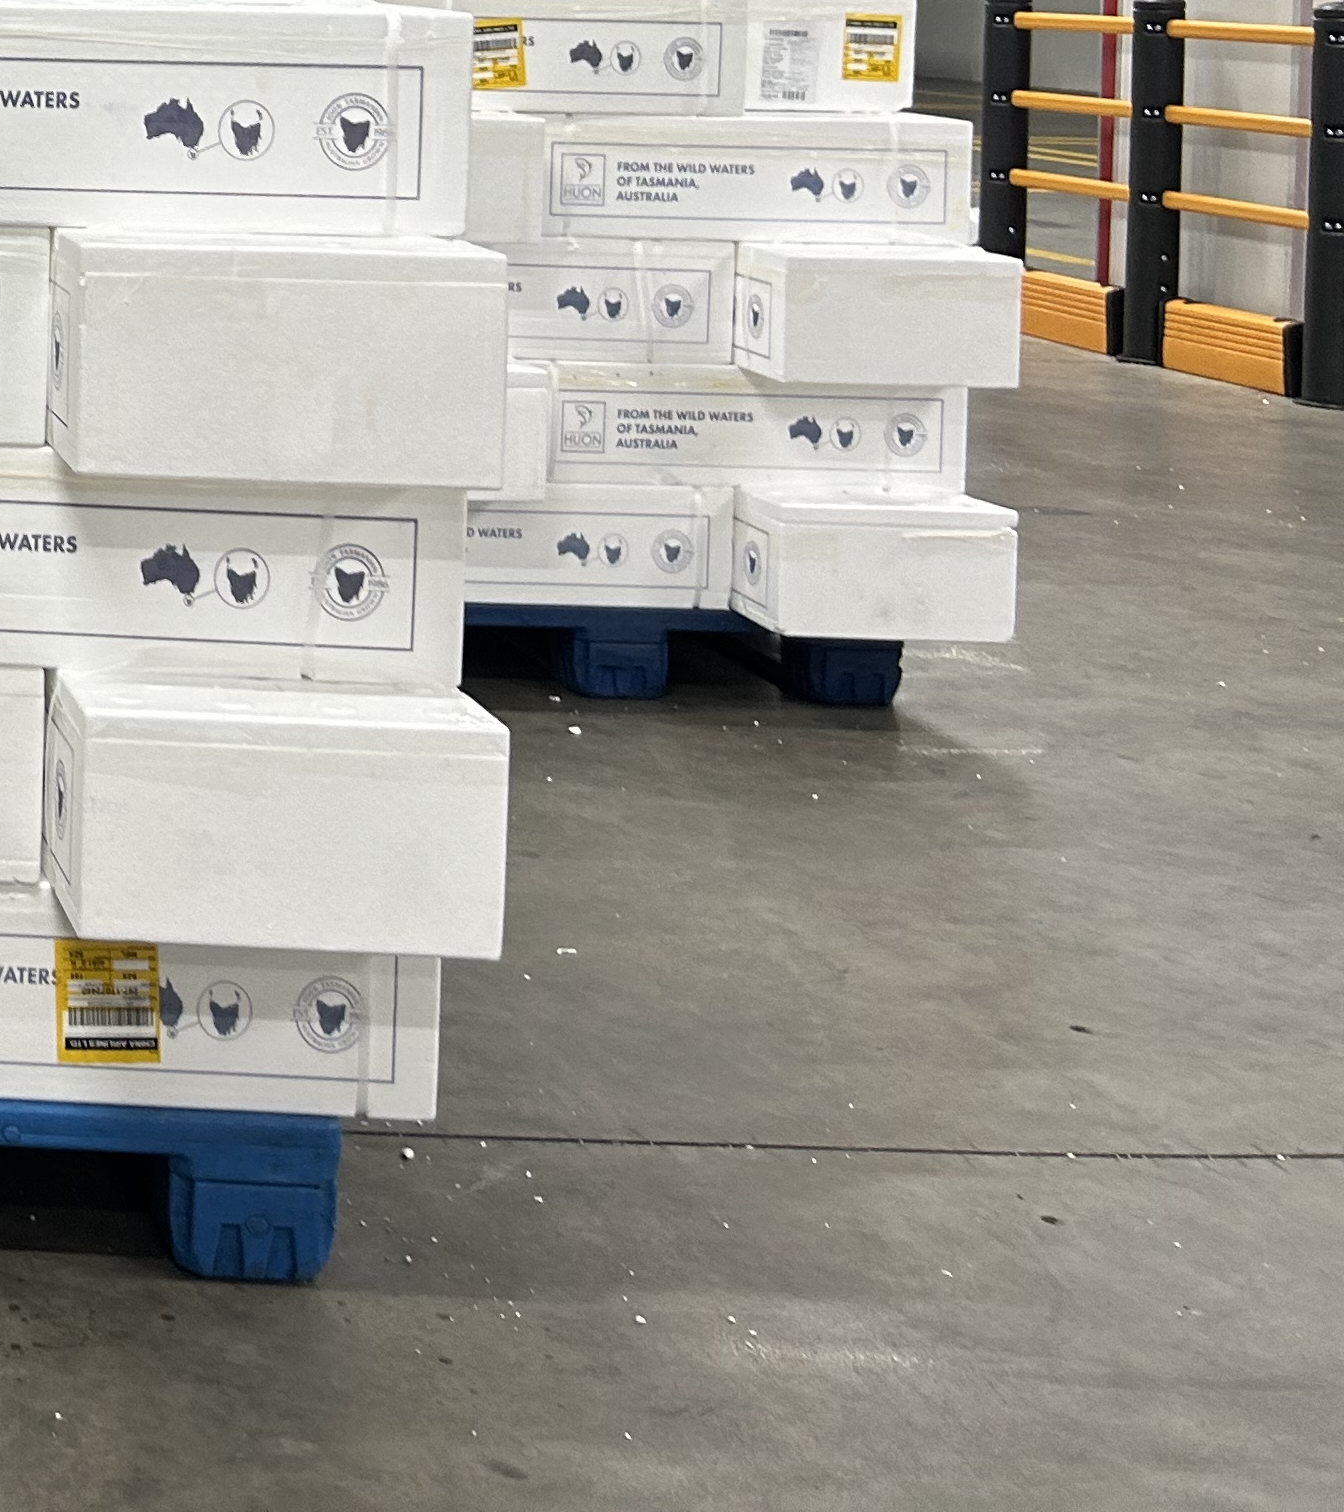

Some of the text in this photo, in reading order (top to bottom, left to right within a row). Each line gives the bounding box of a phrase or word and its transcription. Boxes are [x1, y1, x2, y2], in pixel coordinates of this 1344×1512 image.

[0, 89, 81, 109] WATERS
[617, 161, 755, 175] FROM THE WILD WATERS
[616, 176, 632, 187] OF
[564, 186, 601, 198] HUON
[616, 191, 679, 202] AUSTRALIA
[617, 408, 754, 422] FROM THE WILD WATERS
[616, 423, 632, 434] OF
[564, 433, 601, 445] HUON
[615, 438, 678, 449] AUSTRALIA
[477, 527, 522, 539] WATERS
